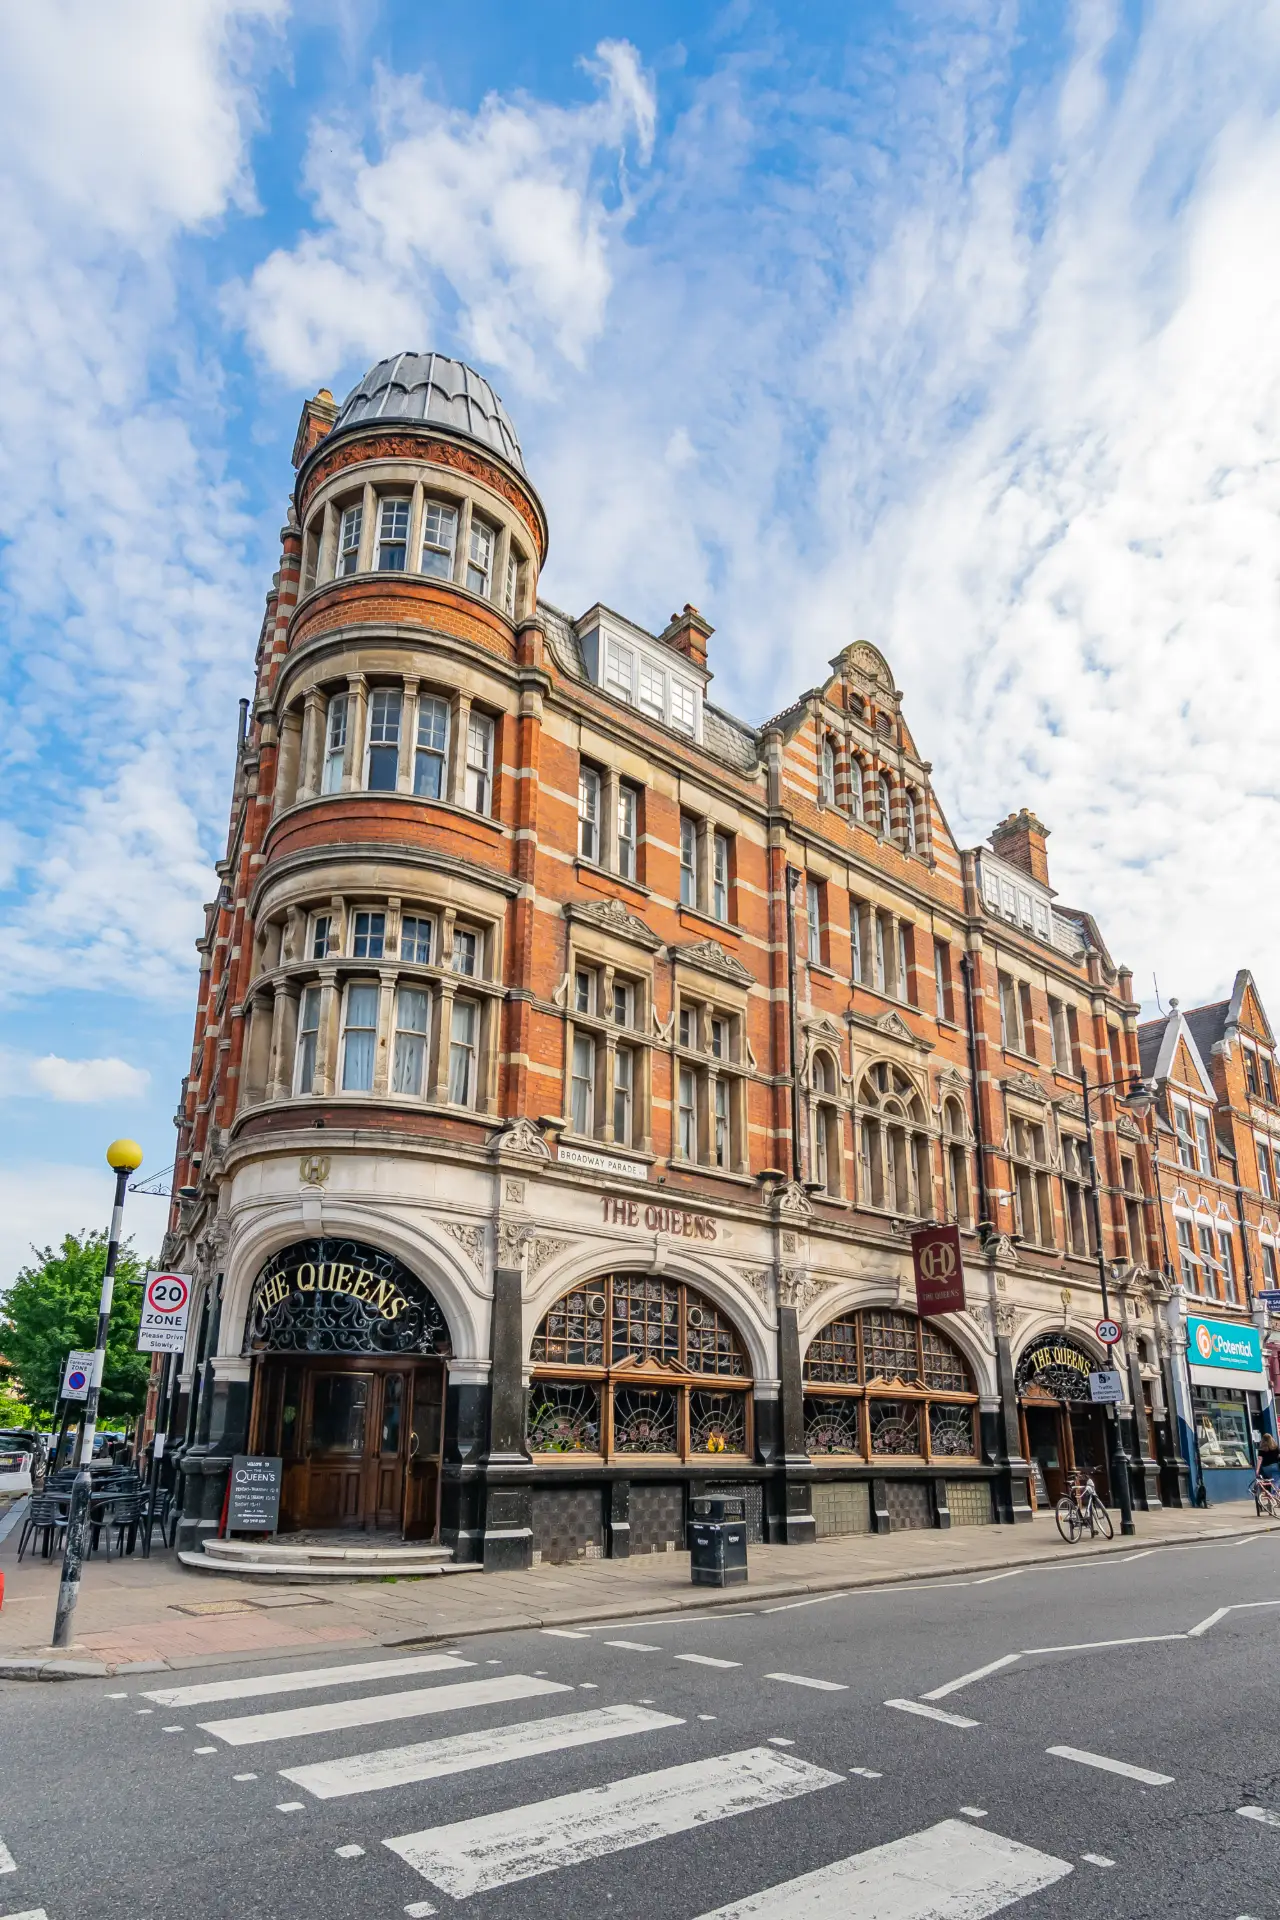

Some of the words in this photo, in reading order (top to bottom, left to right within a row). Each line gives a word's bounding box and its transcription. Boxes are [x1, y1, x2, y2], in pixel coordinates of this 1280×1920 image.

[560, 1150, 605, 1168] BROADWAY
[608, 1160, 637, 1175] PARADE
[600, 1196, 639, 1227] THE
[645, 1205, 717, 1241] QUEENS
[154, 1285, 182, 1302] 20
[257, 1271, 290, 1315] THE
[297, 1262, 409, 1320] QUEENS
[934, 1289, 960, 1300] QUEENS
[146, 1314, 182, 1326] ZONE
[141, 1331, 164, 1339] Please
[165, 1333, 184, 1341] Drive
[1099, 1326, 1118, 1337] 20
[149, 1341, 174, 1349] Slowly
[1031, 1347, 1052, 1371] THE
[1053, 1346, 1091, 1377] QUEENS
[235, 1469, 276, 1483] QUEEN'S
